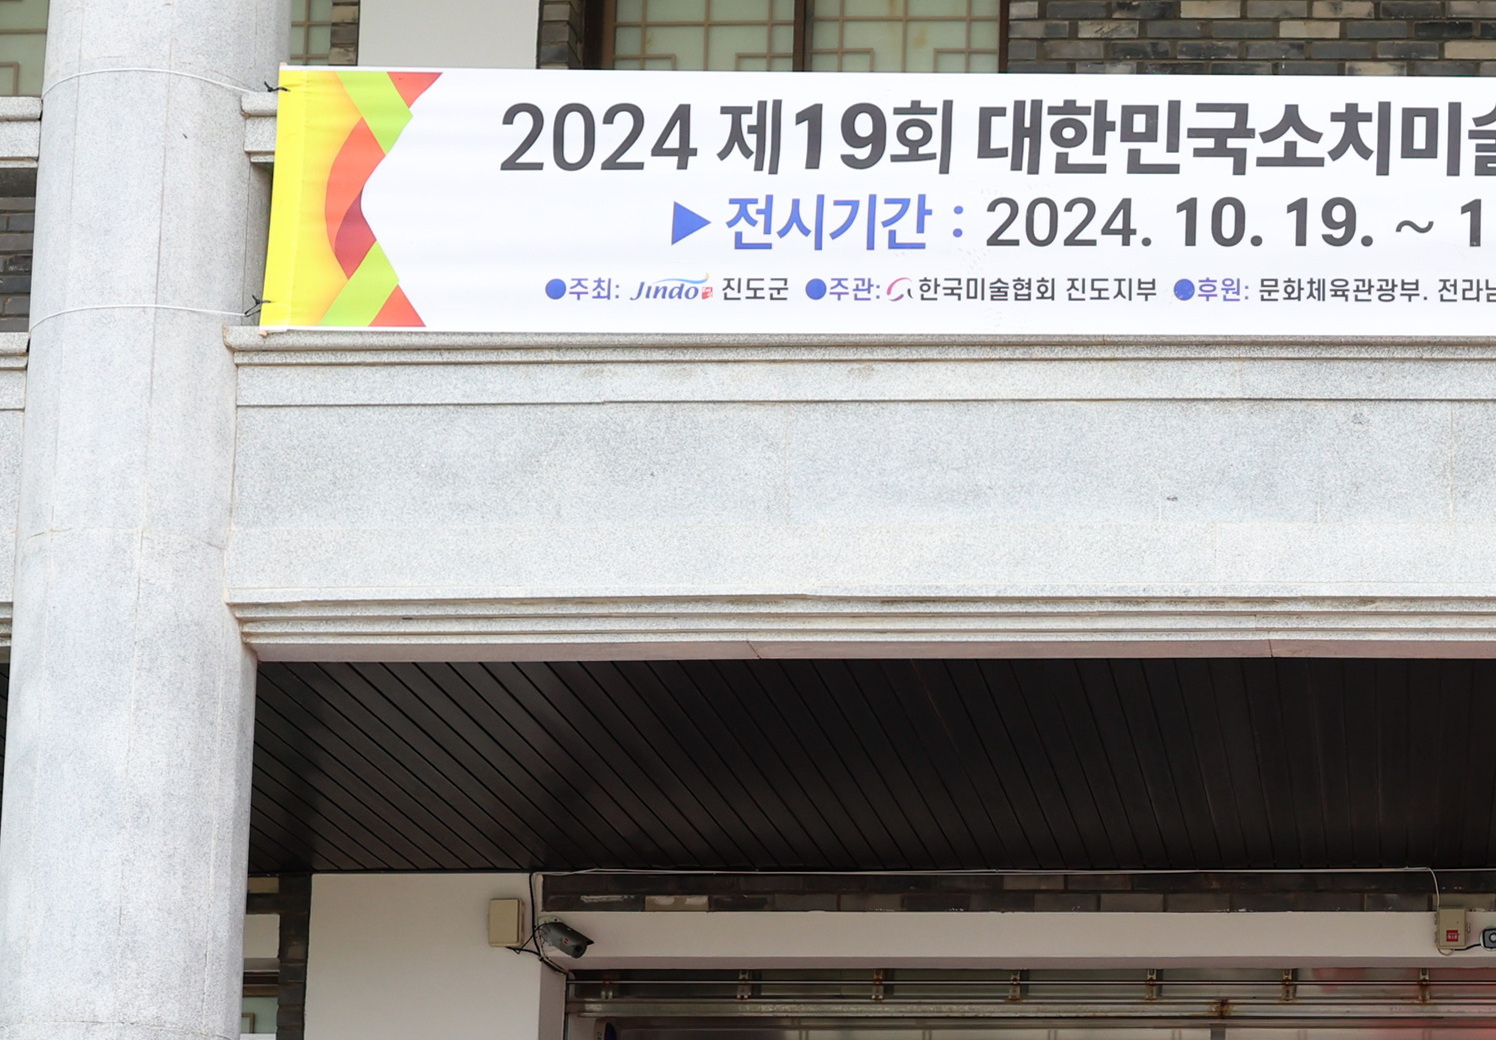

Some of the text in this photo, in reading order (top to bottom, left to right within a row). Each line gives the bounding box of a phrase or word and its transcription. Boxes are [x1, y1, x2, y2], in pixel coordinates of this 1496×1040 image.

[500, 102, 697, 172] 2024
[717, 99, 953, 176] 제19회
[726, 193, 932, 251] 전시기간
[987, 197, 1151, 248] 2024.
[1177, 197, 1262, 247] 10.
[1287, 197, 1373, 248] 19.
[1396, 219, 1433, 234] ~
[569, 278, 620, 301] 주최:
[630, 281, 699, 301] Jindo
[722, 277, 789, 301] 진도군
[829, 277, 881, 302] 주관:
[919, 277, 1055, 302] 한국미술협회
[1067, 277, 1156, 302] 진도지부
[1197, 277, 1249, 302] 후원:
[1259, 278, 1428, 302] 문화체육관광부.
